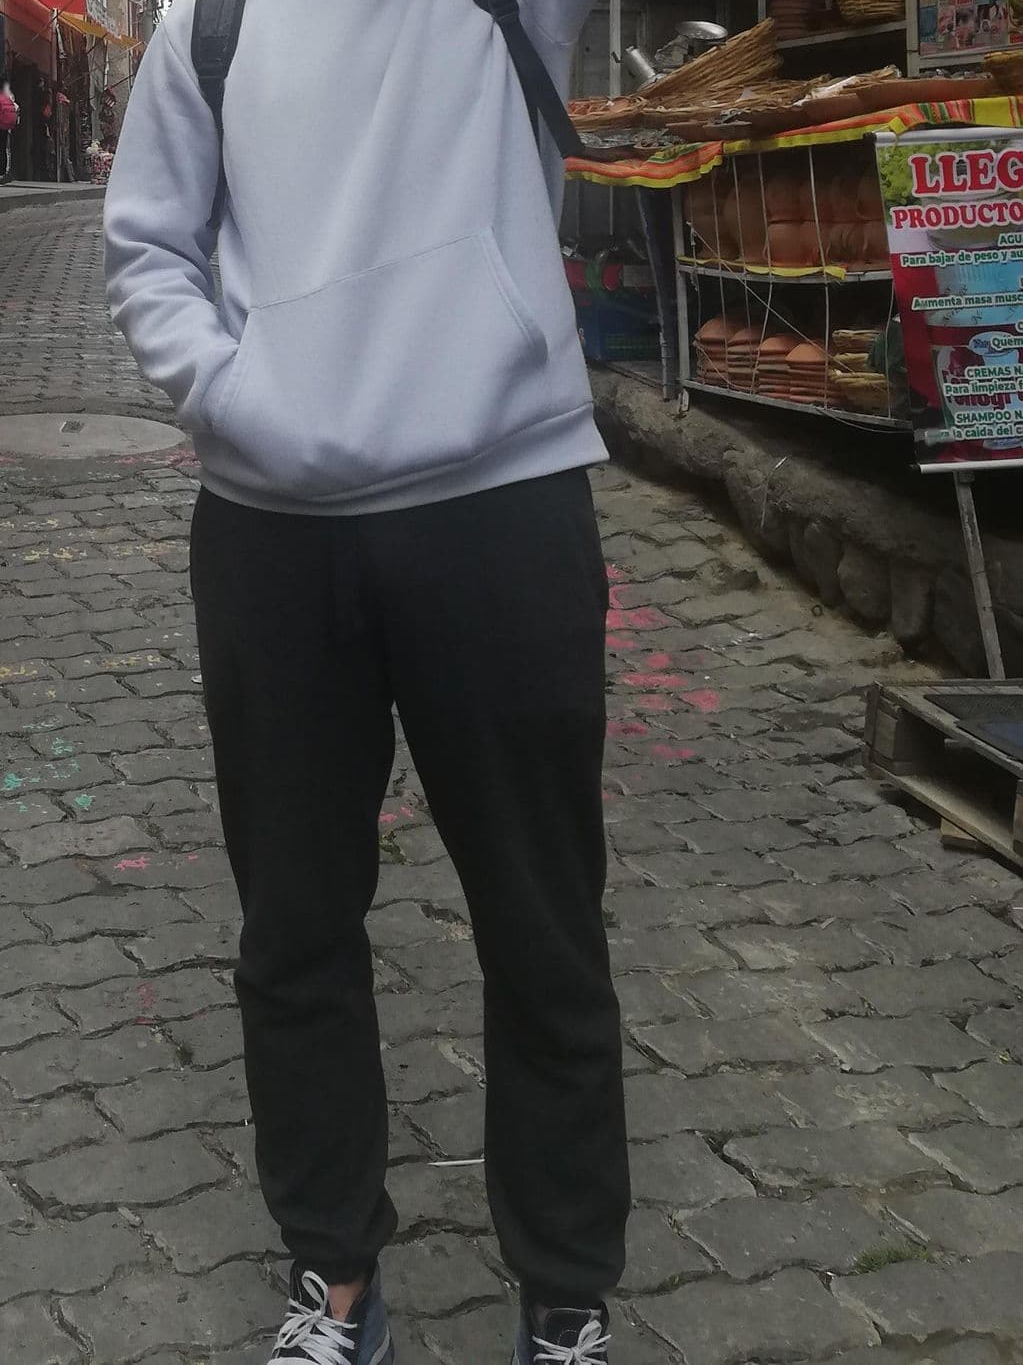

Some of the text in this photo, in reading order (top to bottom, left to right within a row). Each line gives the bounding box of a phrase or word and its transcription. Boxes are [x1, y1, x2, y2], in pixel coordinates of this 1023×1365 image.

[893, 201, 1023, 229] PRODUCTO
[902, 254, 926, 266] Para
[929, 252, 955, 267] bajar
[959, 250, 971, 263] de
[975, 250, 999, 263] peso
[1002, 250, 1008, 260] y
[914, 297, 962, 309] Aumenta
[965, 295, 993, 305] masa
[967, 366, 1011, 378] CREMAS
[945, 384, 969, 395] Para
[972, 380, 1016, 394] limpieza
[956, 411, 1011, 424] SHAMPOO
[996, 425, 1013, 436] del
